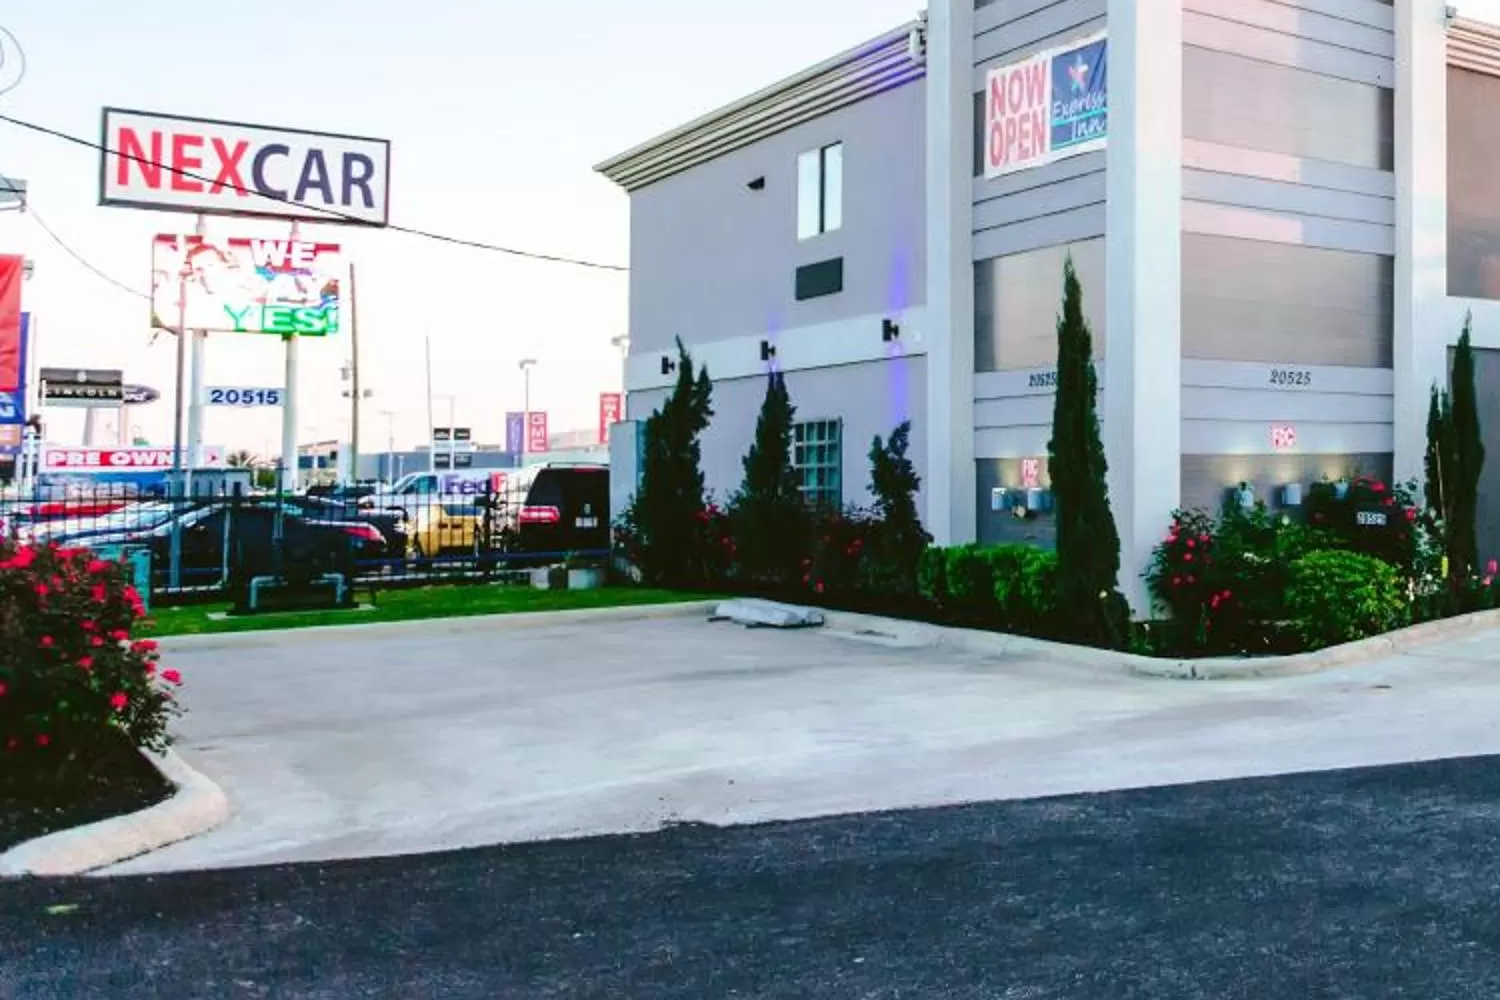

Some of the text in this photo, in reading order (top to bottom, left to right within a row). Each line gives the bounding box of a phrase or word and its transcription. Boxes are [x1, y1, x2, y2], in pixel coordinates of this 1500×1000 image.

[991, 60, 1047, 120] NOW
[990, 106, 1046, 167] OPEN
[116, 126, 375, 208] NEXCAR
[250, 239, 315, 268] WE
[223, 303, 338, 335] YES!
[1269, 369, 1311, 385] 20525
[211, 389, 279, 405] 20515
[531, 414, 546, 451] GMC
[47, 450, 101, 467] PRE
